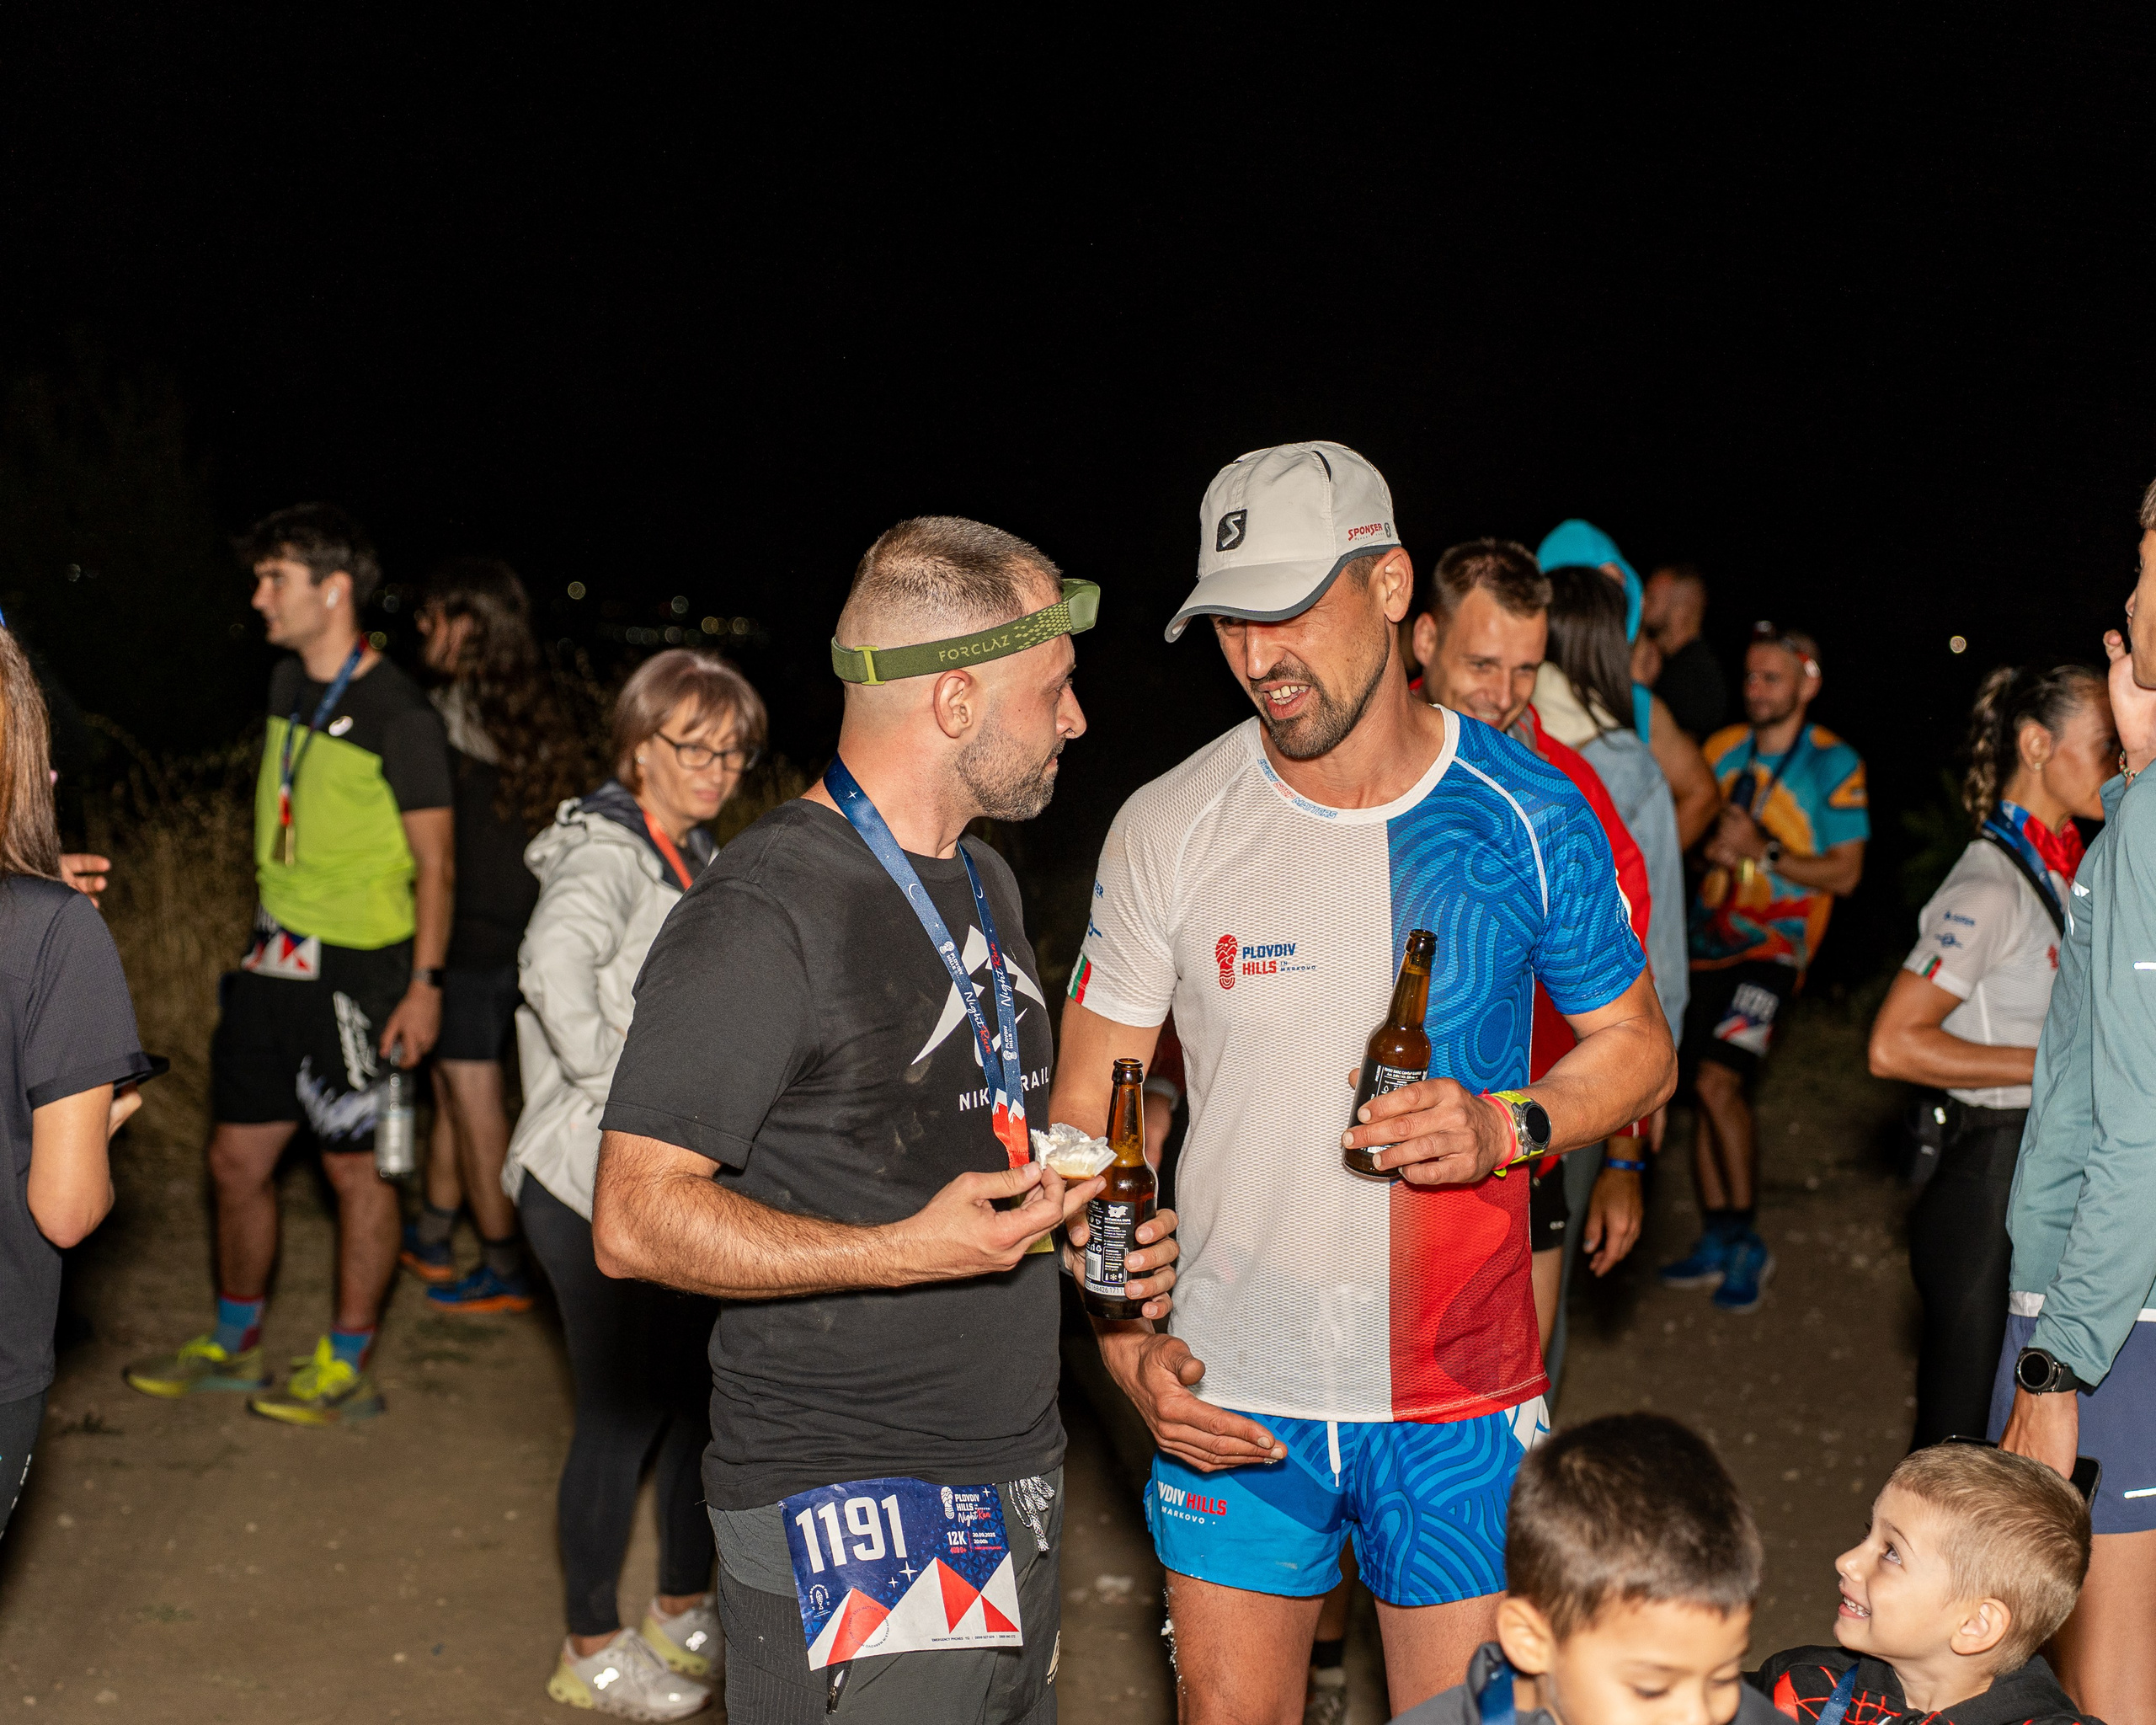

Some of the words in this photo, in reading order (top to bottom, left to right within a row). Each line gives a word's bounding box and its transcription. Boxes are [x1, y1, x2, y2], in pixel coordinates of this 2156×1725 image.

[1348, 523, 1384, 542] SPONSER
[938, 634, 1011, 663] FORCLAZ
[1257, 758, 1279, 782] EVERY
[1273, 782, 1296, 799] STEP
[1291, 797, 1338, 819] MATTERS
[990, 942, 1002, 969] Run
[1242, 943, 1297, 959] PLOVDIV
[946, 955, 957, 971] HILLS
[951, 953, 964, 975] PLOVDIV
[1242, 960, 1277, 975] HILLS
[996, 968, 1012, 1007] Night
[964, 992, 985, 1028] Night
[979, 1025, 991, 1055] Run
[959, 1087, 990, 1112] NIK
[1020, 1066, 1049, 1092] RAIL
[954, 1493, 979, 1503] PLOVDIV
[956, 1503, 974, 1512] HILLS
[1157, 1480, 1186, 1507] VDIV
[1186, 1493, 1228, 1516] HILLS
[958, 1510, 979, 1527] Night
[977, 1509, 991, 1520] Run
[1161, 1506, 1205, 1525] MARKOVO
[794, 1494, 908, 1574] 1191
[947, 1530, 967, 1546] 12K
